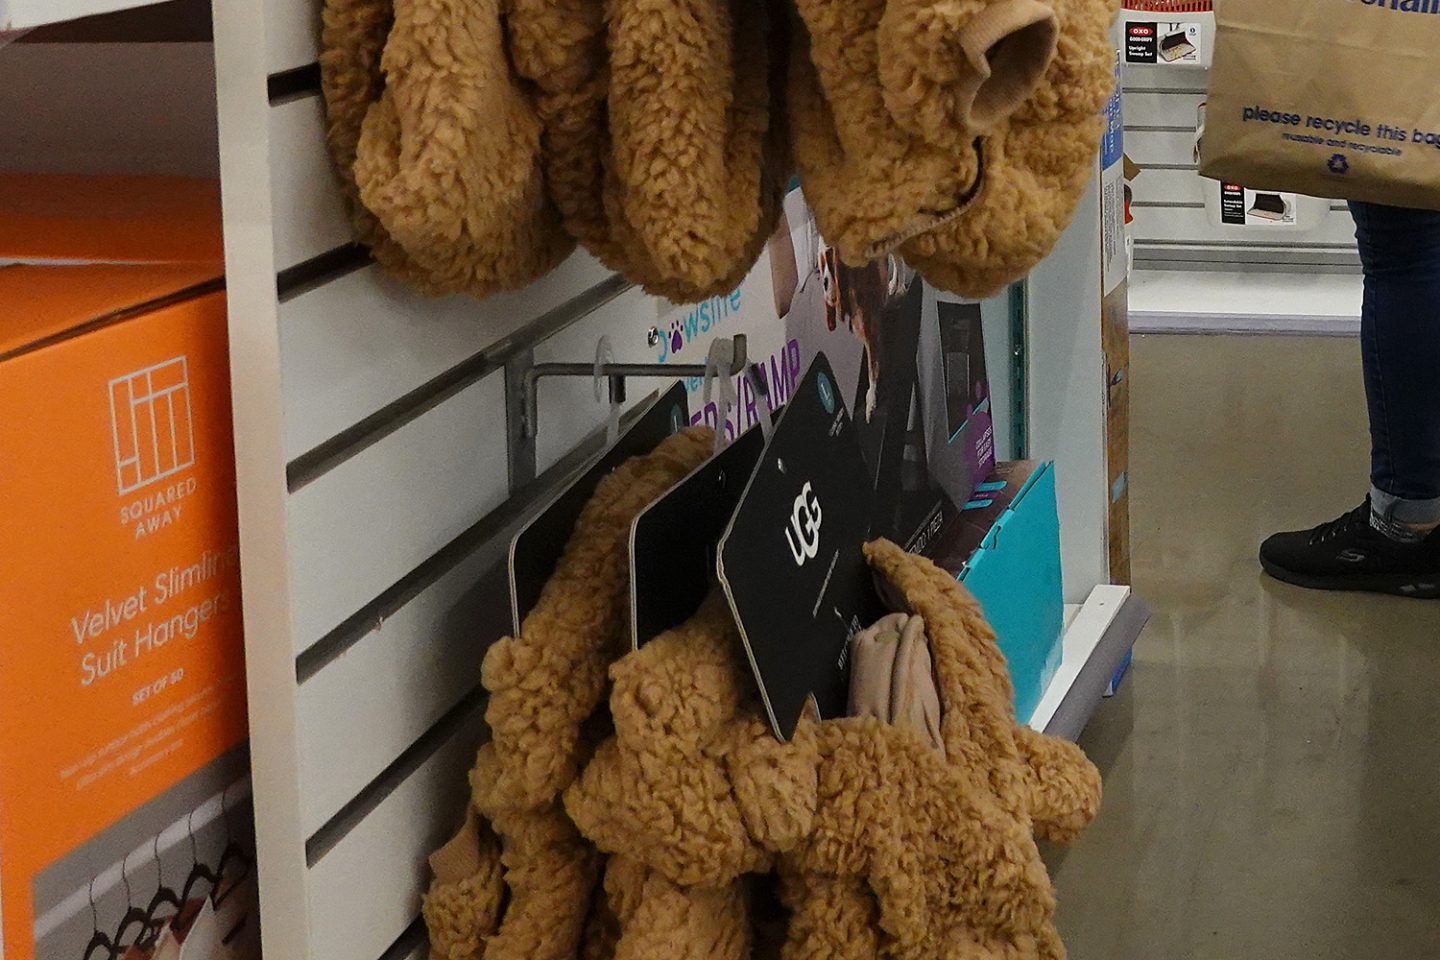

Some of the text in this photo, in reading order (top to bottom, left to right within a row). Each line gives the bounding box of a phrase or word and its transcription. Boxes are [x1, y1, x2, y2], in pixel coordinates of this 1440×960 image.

[1242, 104, 1302, 126] please
[1305, 114, 1371, 136] recycle
[1376, 123, 1409, 142] this
[1282, 132, 1325, 146] reusable
[1326, 138, 1348, 148] and
[120, 476, 197, 526] SQUARED
[135, 506, 183, 540] AWAY
[785, 480, 823, 567] UGG
[70, 585, 149, 646] Velvet
[80, 638, 128, 687] Suit
[131, 685, 152, 707] SET
[152, 676, 169, 696] OF
